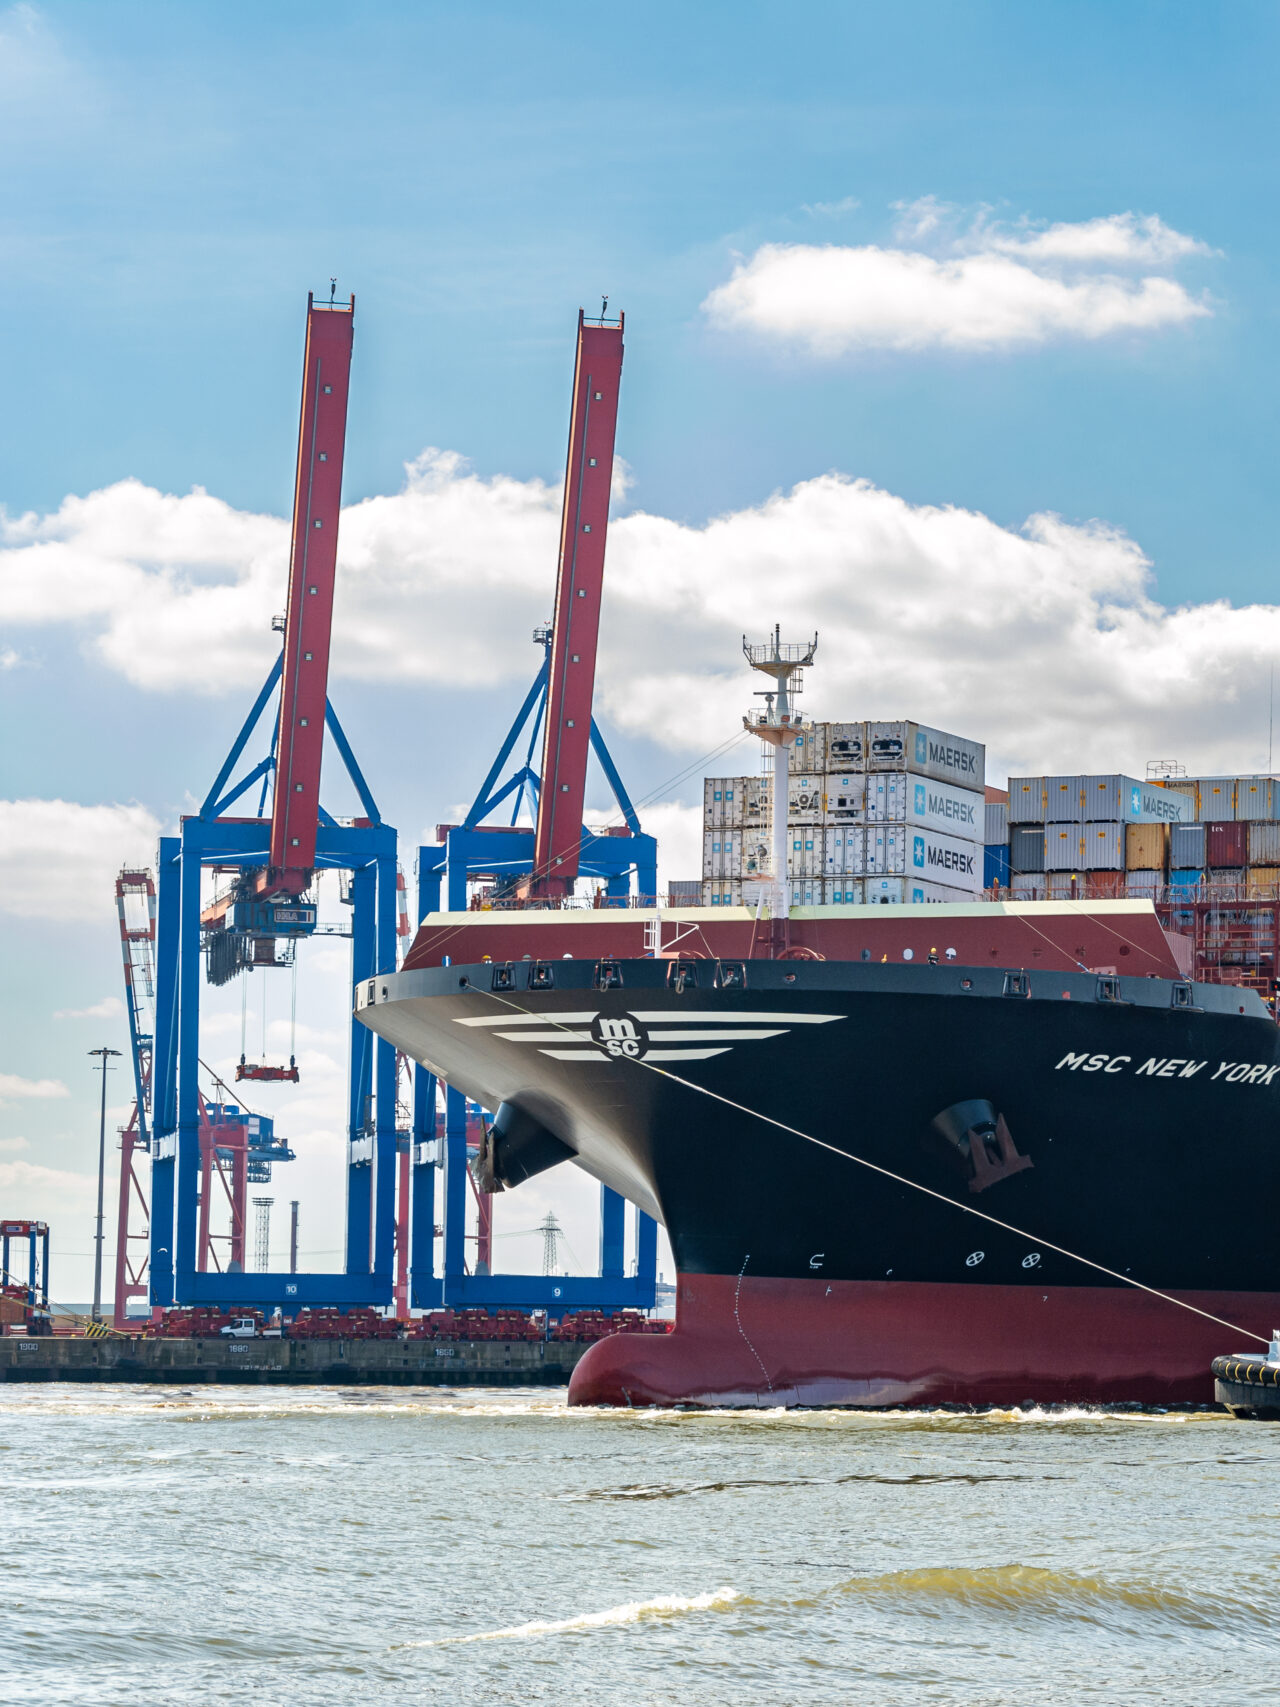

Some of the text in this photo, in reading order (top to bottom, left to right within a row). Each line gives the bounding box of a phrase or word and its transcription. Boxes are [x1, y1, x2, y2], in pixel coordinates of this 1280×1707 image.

[929, 742, 975, 773] MAERSK
[928, 794, 974, 824] MAERSK
[1143, 795, 1182, 822] MAERSK
[928, 845, 974, 875] MAERSK
[1055, 1052, 1131, 1073] MSC
[1135, 1058, 1208, 1078] NEW
[286, 1285, 297, 1294] 10
[553, 1287, 561, 1297] 9
[19, 1342, 38, 1351] 1900
